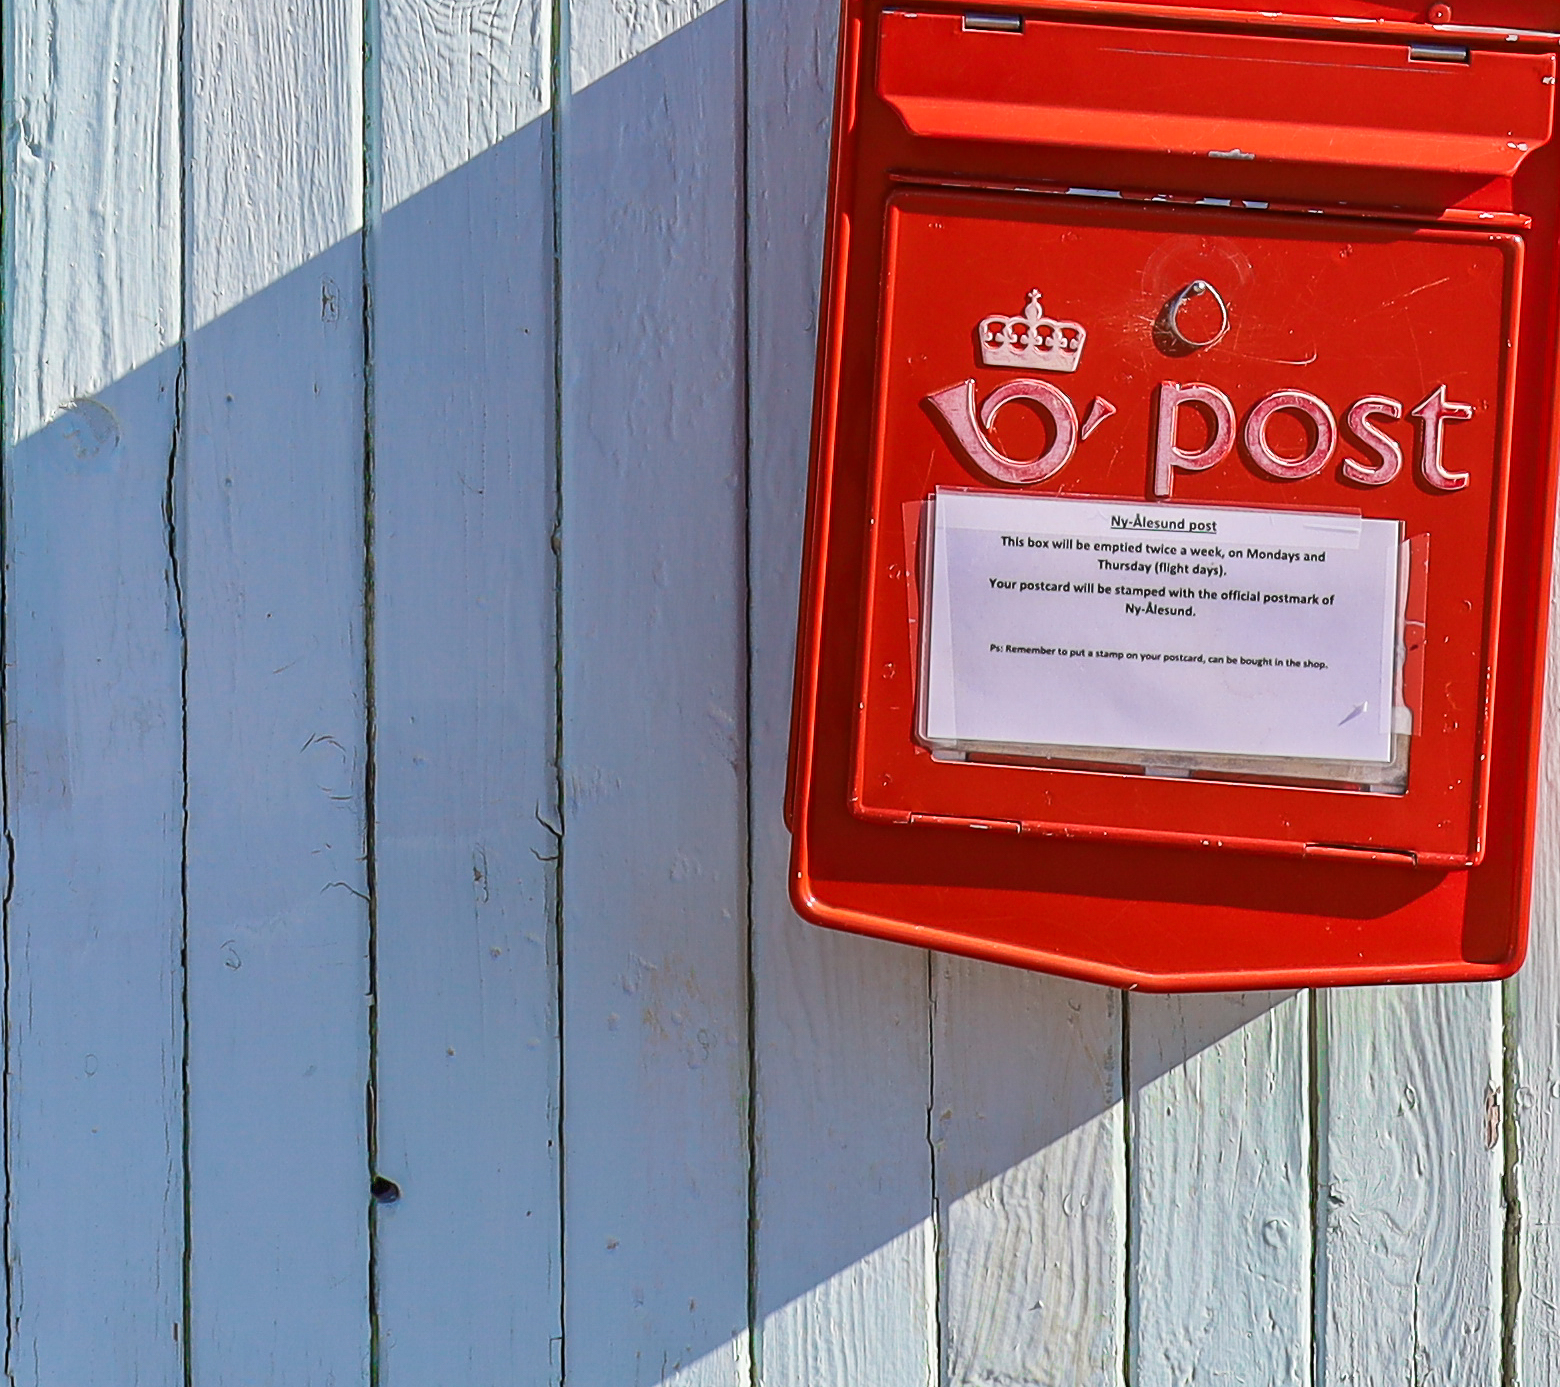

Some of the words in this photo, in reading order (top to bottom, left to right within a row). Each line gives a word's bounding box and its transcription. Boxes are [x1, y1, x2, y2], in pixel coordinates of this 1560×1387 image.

[1153, 379, 1474, 498] post
[1110, 513, 1185, 532] Ny-Ålesund
[1188, 520, 1218, 534] post
[1000, 535, 1024, 548] This
[1027, 537, 1049, 549] box
[1052, 539, 1073, 550] will
[1075, 539, 1091, 551] be
[1093, 541, 1142, 554] emptied
[1145, 543, 1177, 555] twice
[1180, 547, 1187, 556] a
[1189, 546, 1225, 559] week,
[1228, 549, 1243, 559] on
[1246, 548, 1300, 563] Mondays
[1303, 551, 1326, 563] and
[1097, 559, 1152, 575] Thursday
[1154, 561, 1189, 576] (flight
[1192, 564, 1227, 577] days).
[989, 578, 1017, 590] Your
[1019, 580, 1071, 593] postcard
[1073, 583, 1094, 594] will
[1097, 583, 1111, 595] be
[1114, 585, 1166, 598] stamped
[1168, 587, 1195, 599] with
[1198, 589, 1217, 600] the
[1220, 590, 1260, 602] official
[1263, 593, 1319, 605] postmark
[1321, 594, 1335, 606] of
[1125, 601, 1196, 617] Ny-Ålesund.
[989, 643, 1004, 653] Ps:
[1005, 644, 1055, 656] Remember
[1058, 647, 1067, 656] to
[1069, 649, 1086, 658] put
[1087, 650, 1093, 658] a
[1095, 650, 1124, 660] stamp
[1126, 652, 1138, 660] on
[1140, 653, 1161, 662] your
[1163, 654, 1206, 665] postcard,
[1208, 656, 1224, 664] can
[1226, 655, 1238, 665] be
[1240, 656, 1272, 667] bought
[1274, 657, 1283, 667] in
[1285, 658, 1301, 668] the
[1303, 659, 1329, 670] shop.
